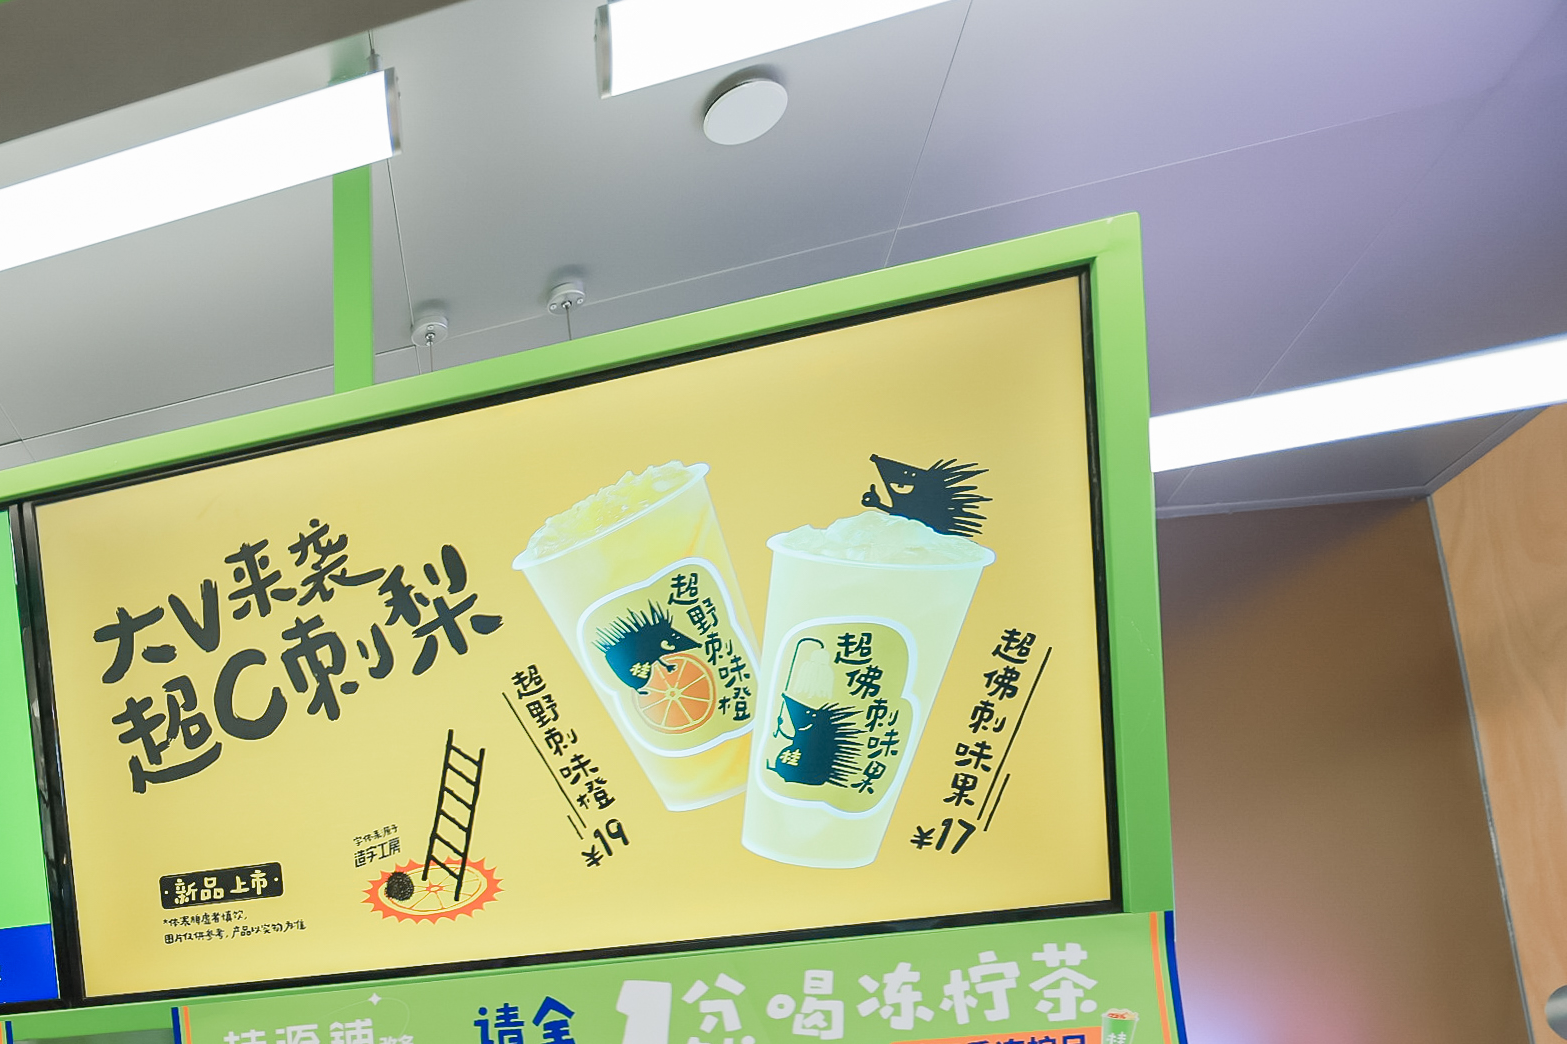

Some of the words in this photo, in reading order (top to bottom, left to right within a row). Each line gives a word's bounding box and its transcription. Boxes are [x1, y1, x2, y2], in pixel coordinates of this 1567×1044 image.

[93, 518, 386, 684] 大V来袭
[668, 572, 752, 721] 超野刺味橙
[111, 544, 504, 795] 超C刺梨
[511, 663, 616, 810] 超野刺味橙
[174, 870, 268, 905] 新品上市
[581, 818, 630, 868] ¥19
[910, 817, 977, 855] ¥17
[766, 942, 1098, 1042] 喝冻柠茶
